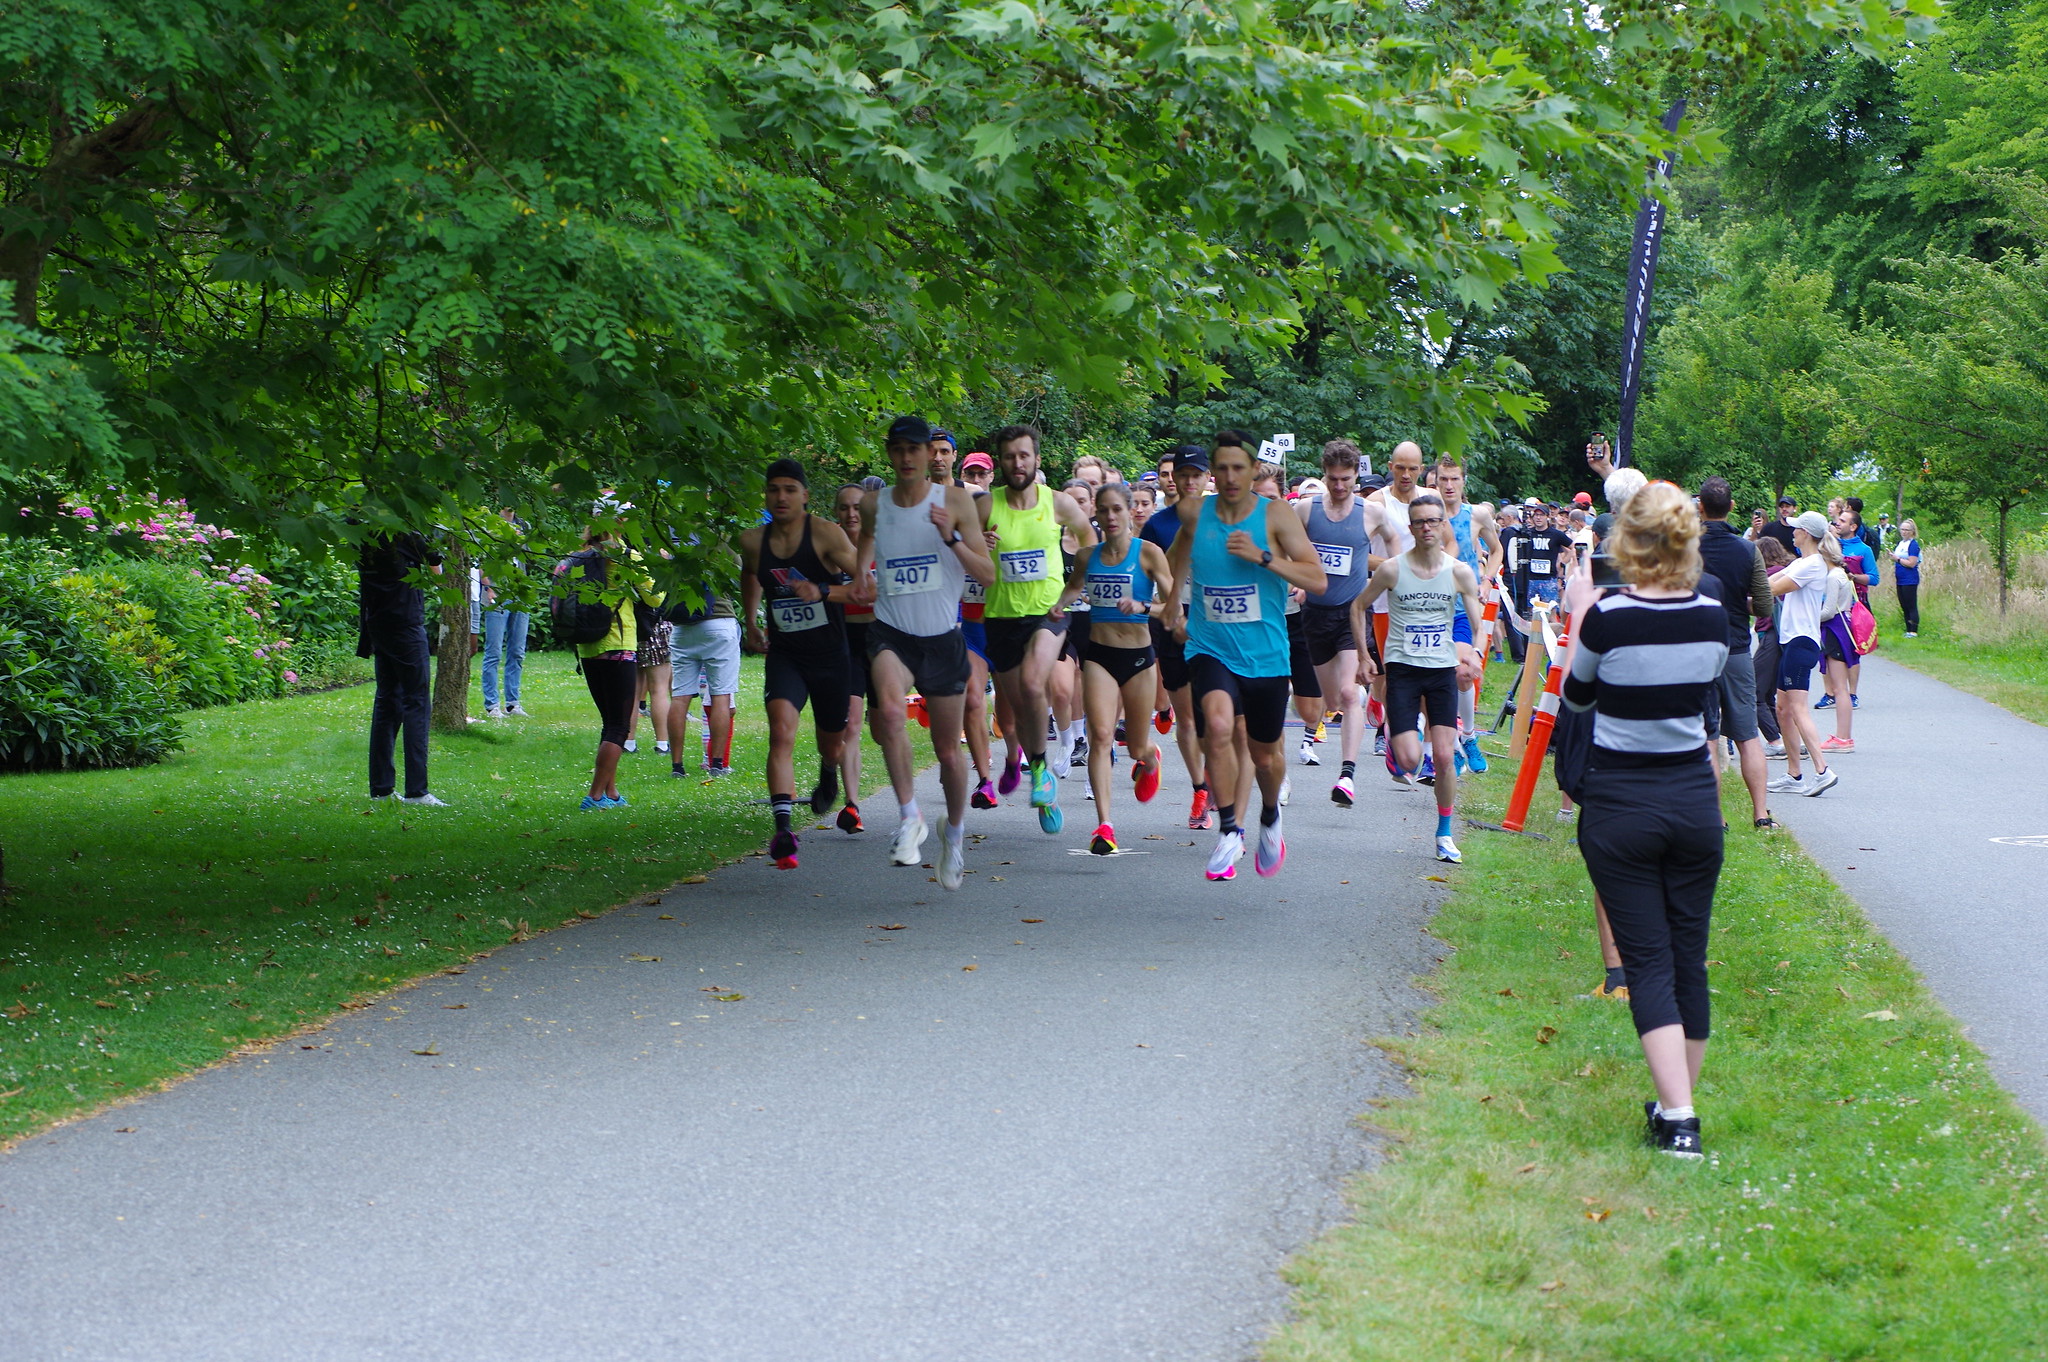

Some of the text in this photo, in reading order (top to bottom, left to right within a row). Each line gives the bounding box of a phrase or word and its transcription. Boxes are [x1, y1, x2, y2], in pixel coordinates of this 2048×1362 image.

[1278, 438, 1290, 447] 60
[1264, 447, 1277, 458] 55
[1360, 461, 1368, 472] 50
[1008, 559, 1039, 575] 132
[894, 566, 929, 585] 407
[1093, 584, 1122, 599] 428
[1397, 592, 1452, 602] VANCOUVER
[1212, 597, 1248, 614] 423
[782, 606, 815, 624] 450
[1411, 633, 1441, 648] 412
